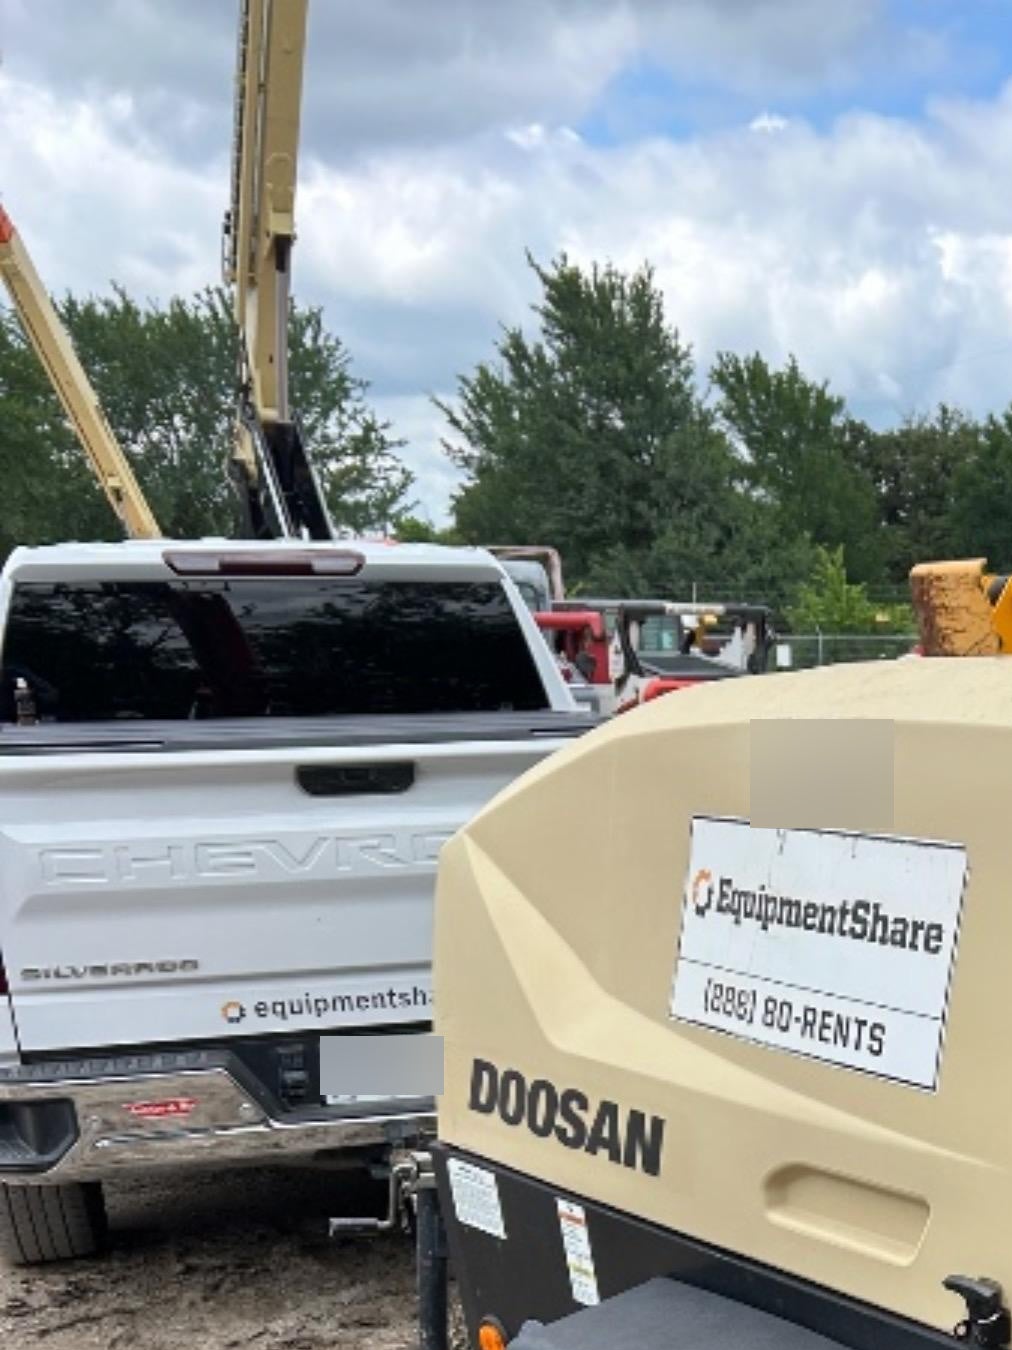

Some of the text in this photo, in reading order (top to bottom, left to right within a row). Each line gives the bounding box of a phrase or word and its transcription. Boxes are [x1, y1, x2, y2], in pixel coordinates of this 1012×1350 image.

[716, 877, 944, 955] EquipmentShare
[20, 959, 200, 981] SILVERADO
[703, 977, 887, 1057] (888) 80-RENTS
[469, 1058, 667, 1177] DOOSAN
